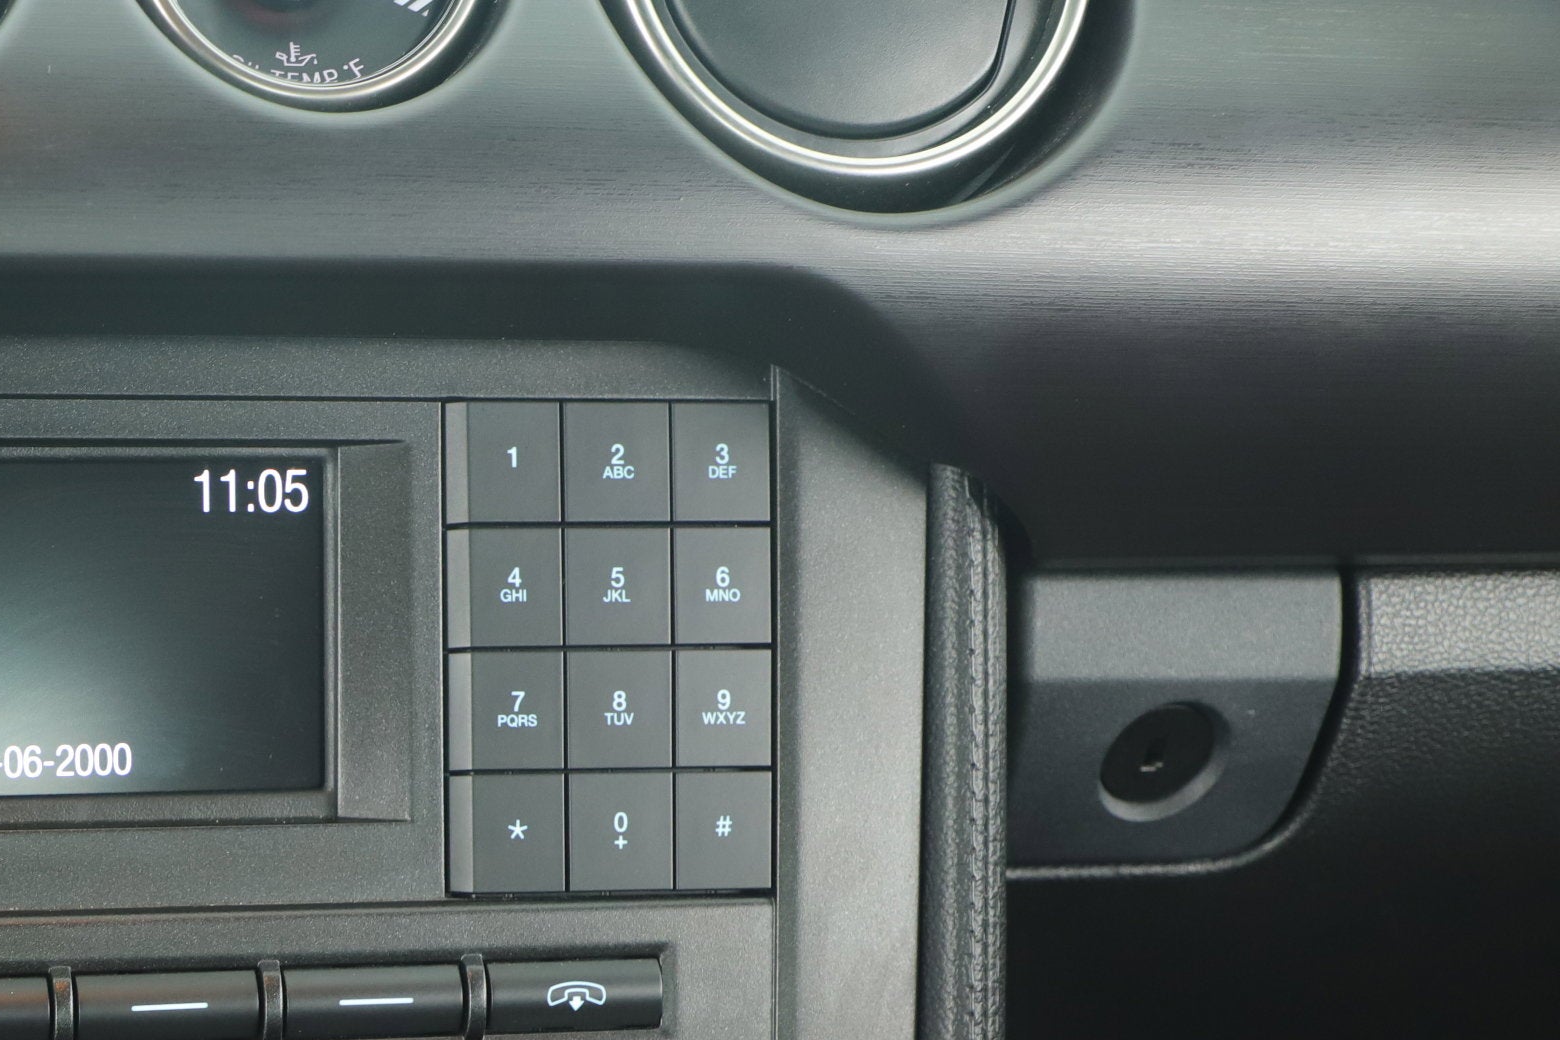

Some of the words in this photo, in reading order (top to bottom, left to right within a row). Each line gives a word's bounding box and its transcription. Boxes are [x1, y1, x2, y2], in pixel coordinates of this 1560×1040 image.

[506, 446, 518, 468] 1
[610, 443, 625, 465] 2
[714, 443, 730, 465] 3
[602, 465, 635, 480] ABC
[708, 465, 737, 479] DEF
[192, 467, 310, 514] 11:05
[507, 566, 522, 588] 4
[610, 566, 625, 588] 5
[715, 566, 730, 588] 6
[500, 588, 528, 603] GHI
[602, 589, 632, 603] JKL
[705, 588, 741, 603] MNO
[510, 690, 526, 712] 7
[612, 690, 627, 712] 8
[716, 689, 731, 711] 9
[496, 713, 538, 728] PQRS
[604, 711, 635, 726] TUV
[701, 711, 747, 726] WXYZ
[613, 811, 629, 833] 0
